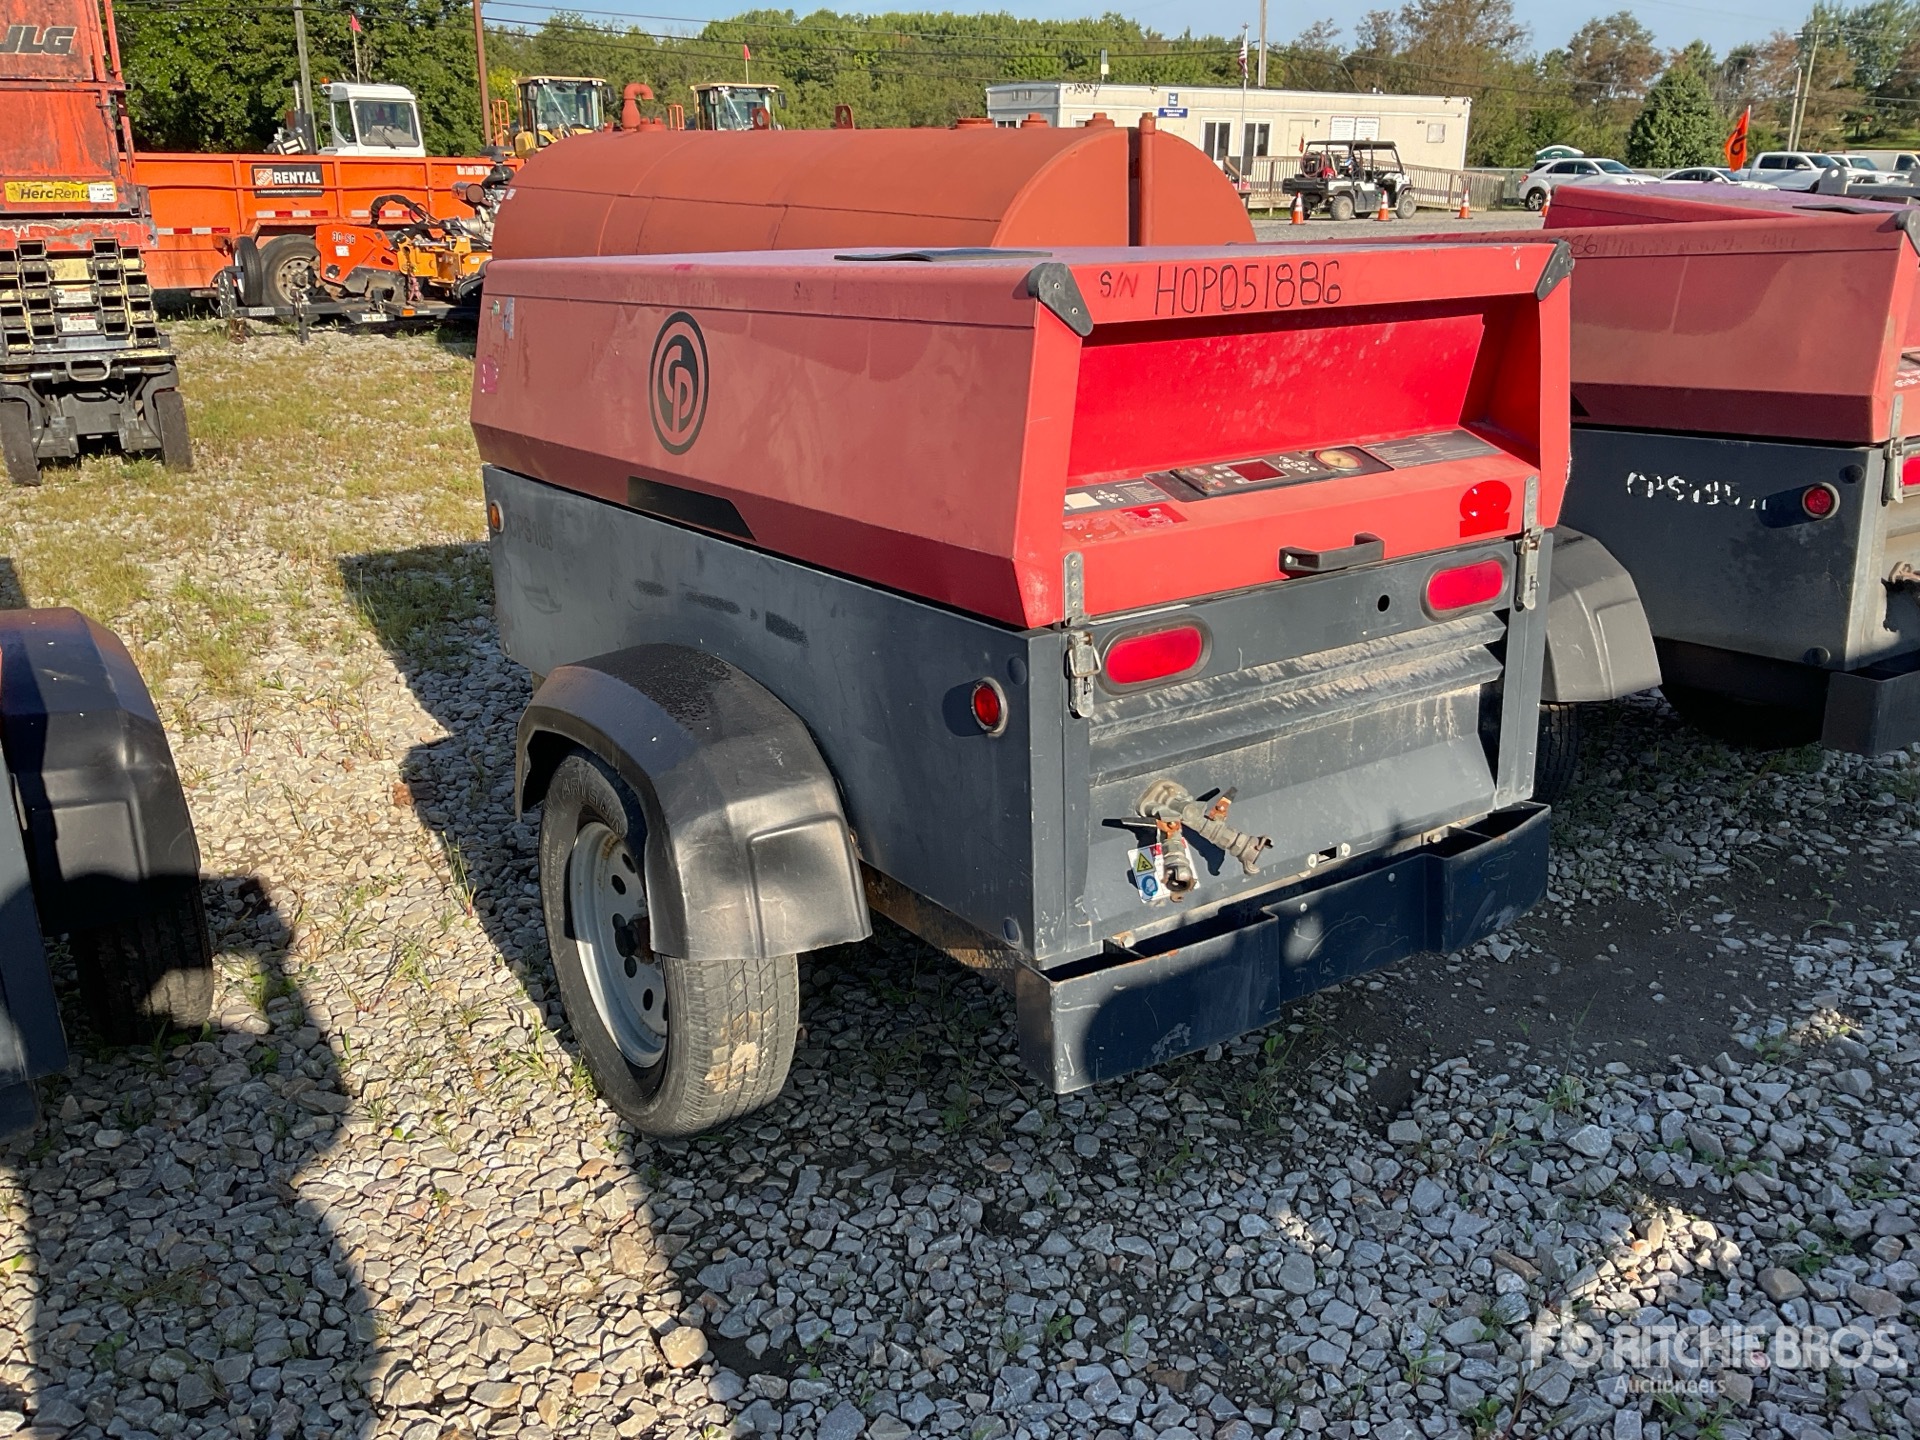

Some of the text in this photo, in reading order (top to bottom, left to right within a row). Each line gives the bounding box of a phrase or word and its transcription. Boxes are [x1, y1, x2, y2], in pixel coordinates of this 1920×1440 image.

[0, 25, 77, 55] JLG
[273, 171, 321, 184] RENTAL
[1099, 270, 1139, 299] S/N
